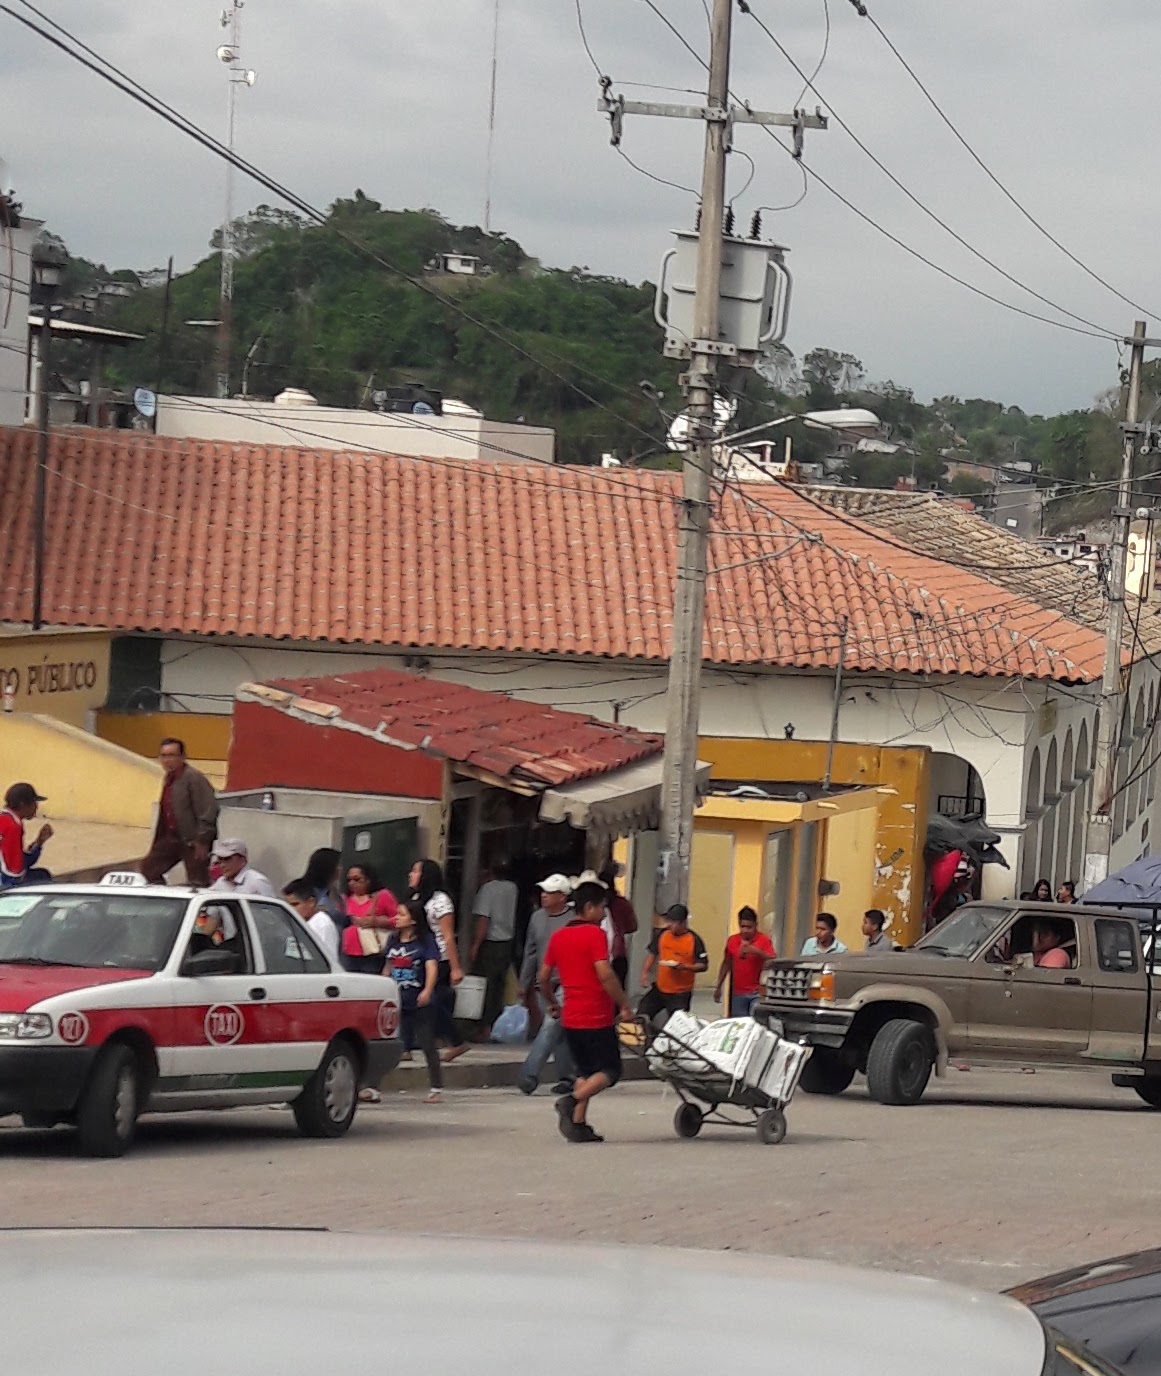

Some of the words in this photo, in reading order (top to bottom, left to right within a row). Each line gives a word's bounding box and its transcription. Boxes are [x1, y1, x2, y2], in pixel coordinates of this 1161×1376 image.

[27, 655, 97, 696] PÚBLICO
[109, 874, 135, 885] TAXI
[210, 1012, 238, 1036] TAXI
